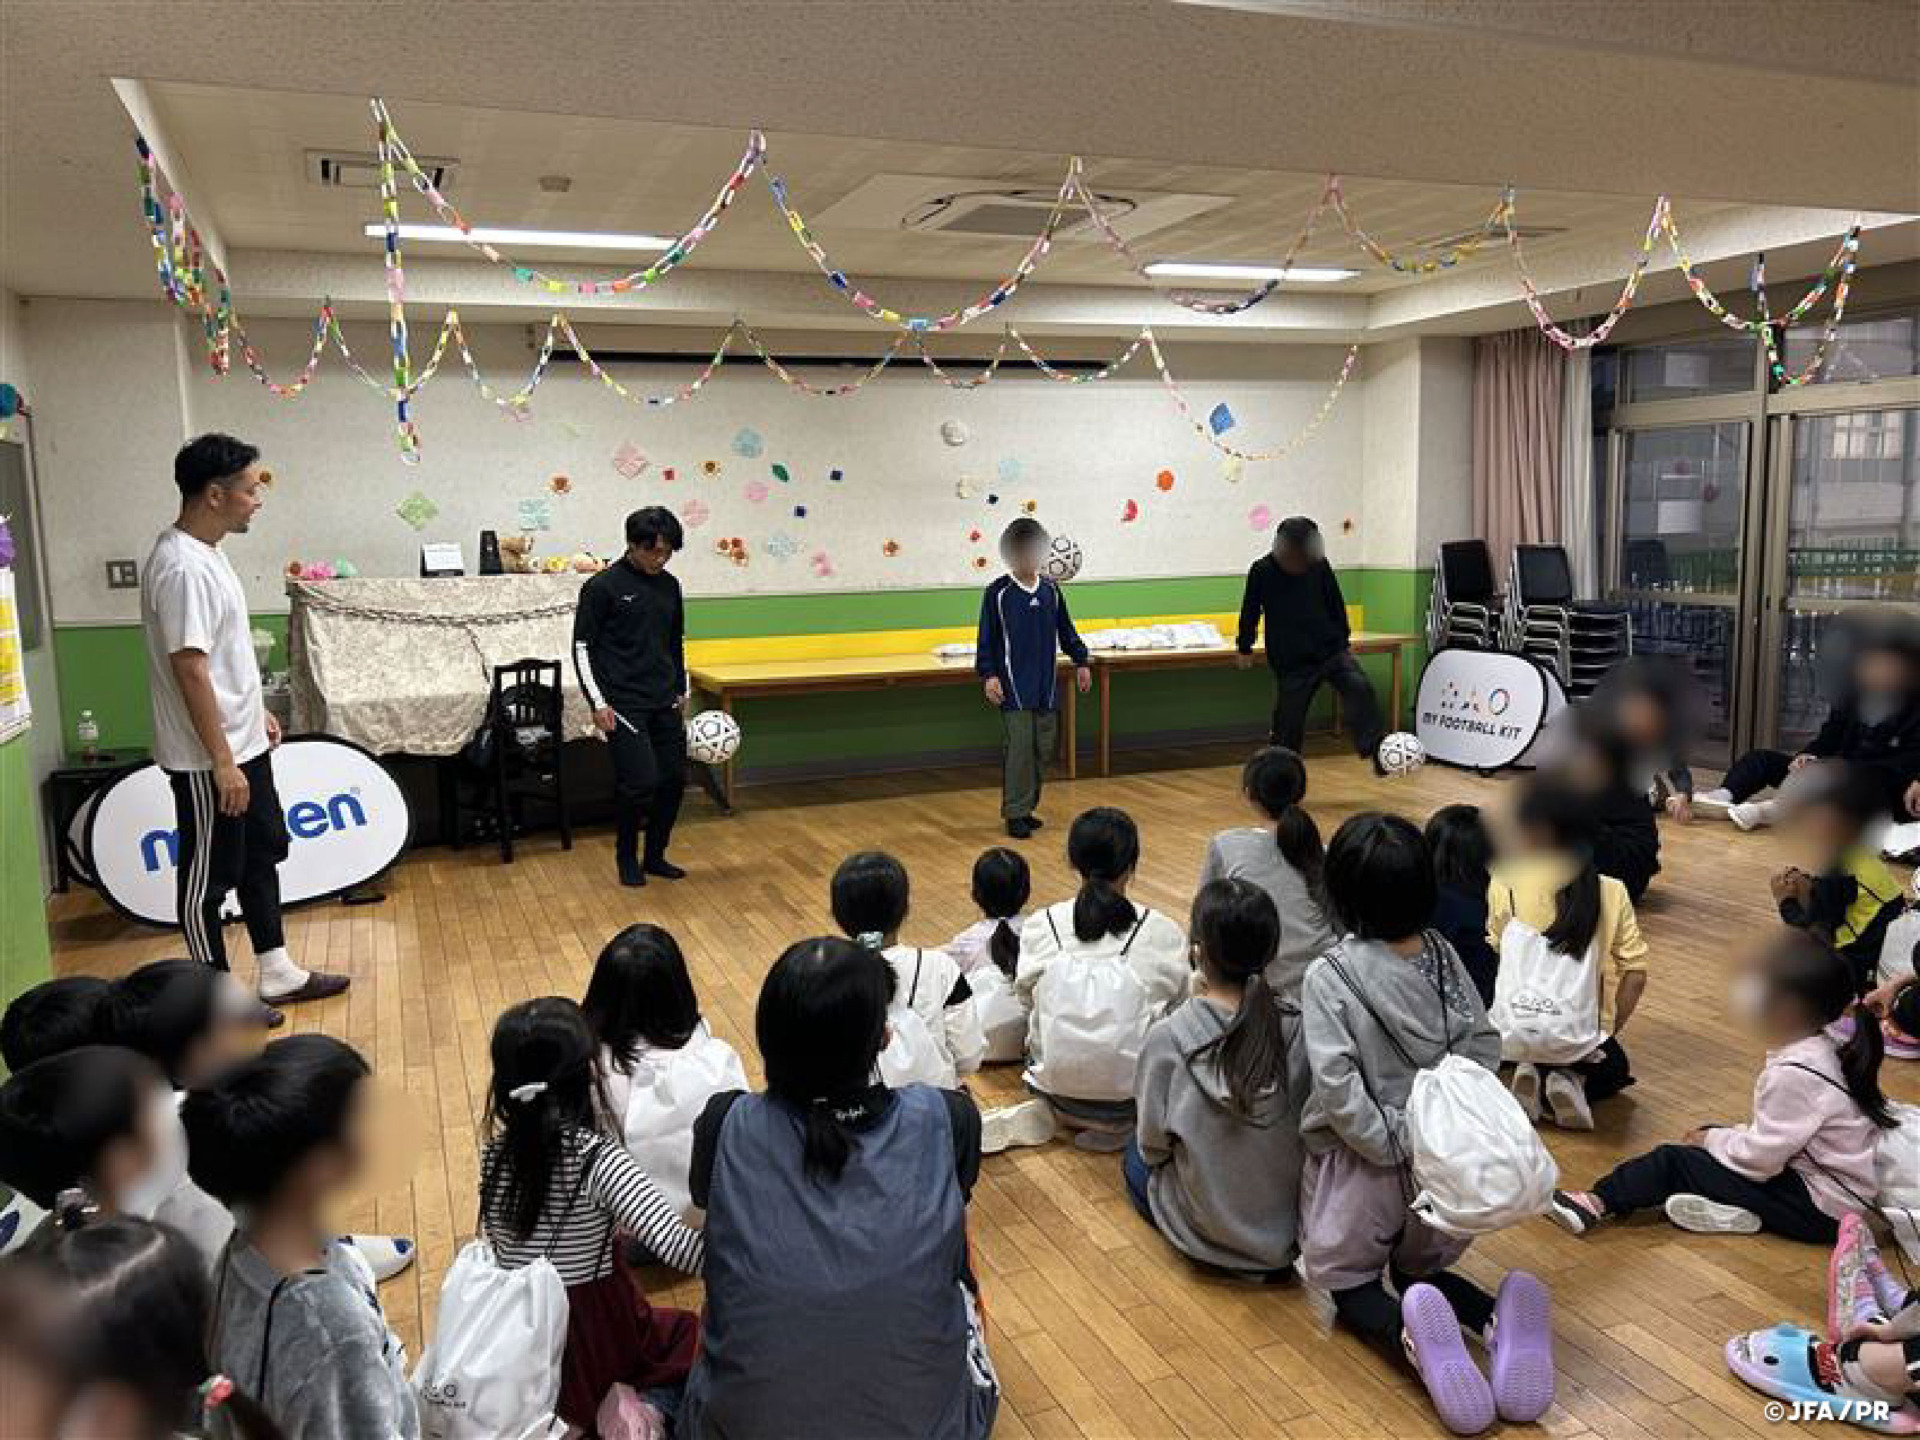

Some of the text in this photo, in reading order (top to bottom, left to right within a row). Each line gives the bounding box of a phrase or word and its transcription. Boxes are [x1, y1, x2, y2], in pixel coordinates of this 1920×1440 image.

[1422, 712, 1523, 739] MY FOOTBALL KIT
[140, 793, 367, 872] men
